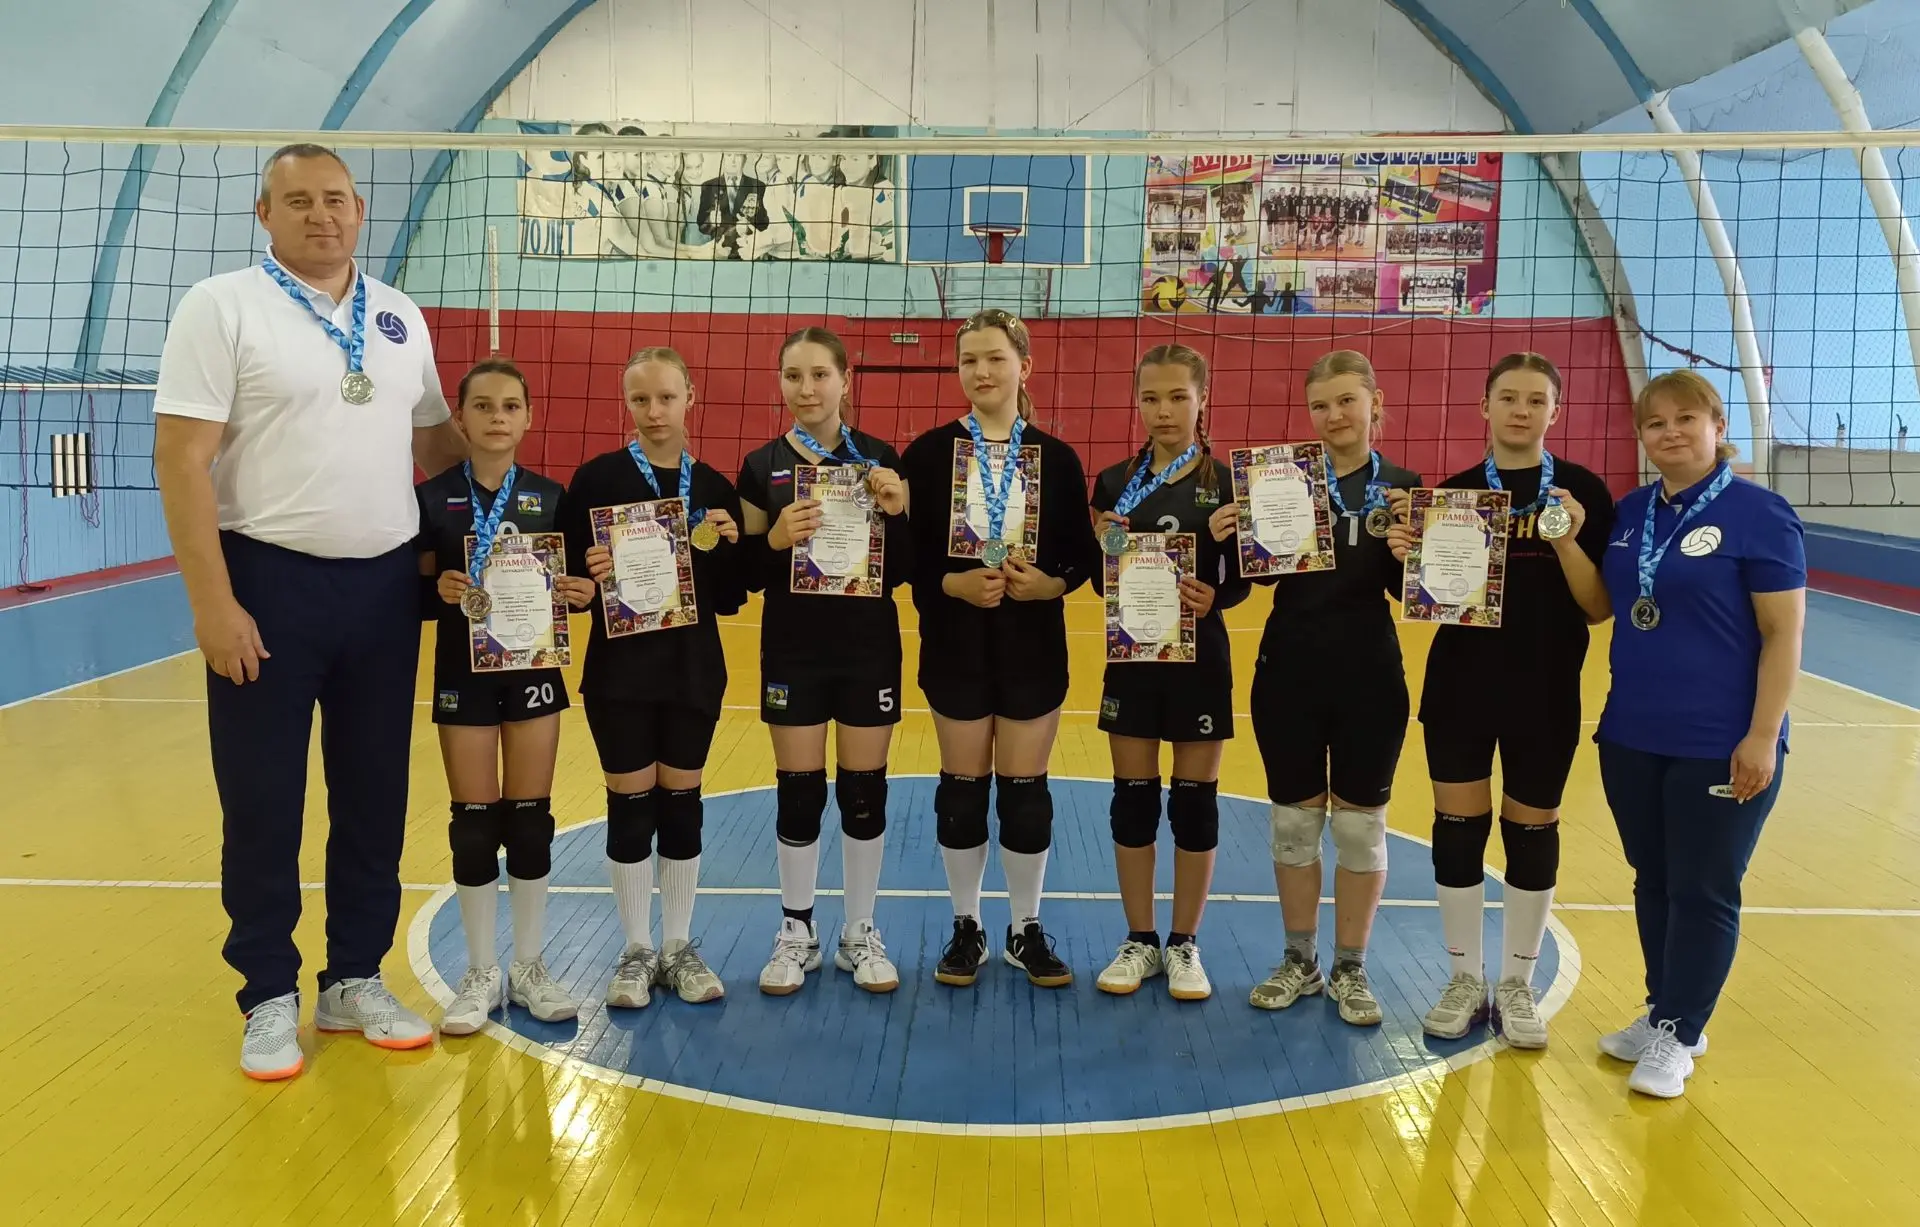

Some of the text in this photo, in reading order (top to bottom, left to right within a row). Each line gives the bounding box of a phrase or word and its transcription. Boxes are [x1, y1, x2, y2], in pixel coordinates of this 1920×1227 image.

[544, 219, 575, 255] ЛЕТ
[1259, 467, 1300, 477] ГРАМОТА
[821, 489, 851, 497] ГРАМО
[1436, 513, 1481, 522] ГРАМОТА
[621, 525, 661, 536] ГРАМОТА
[495, 559, 538, 567] ГРАМОТА
[1640, 606, 1651, 623] 2
[524, 682, 554, 709] 20
[878, 687, 894, 712] 5
[1198, 714, 1214, 735] 3
